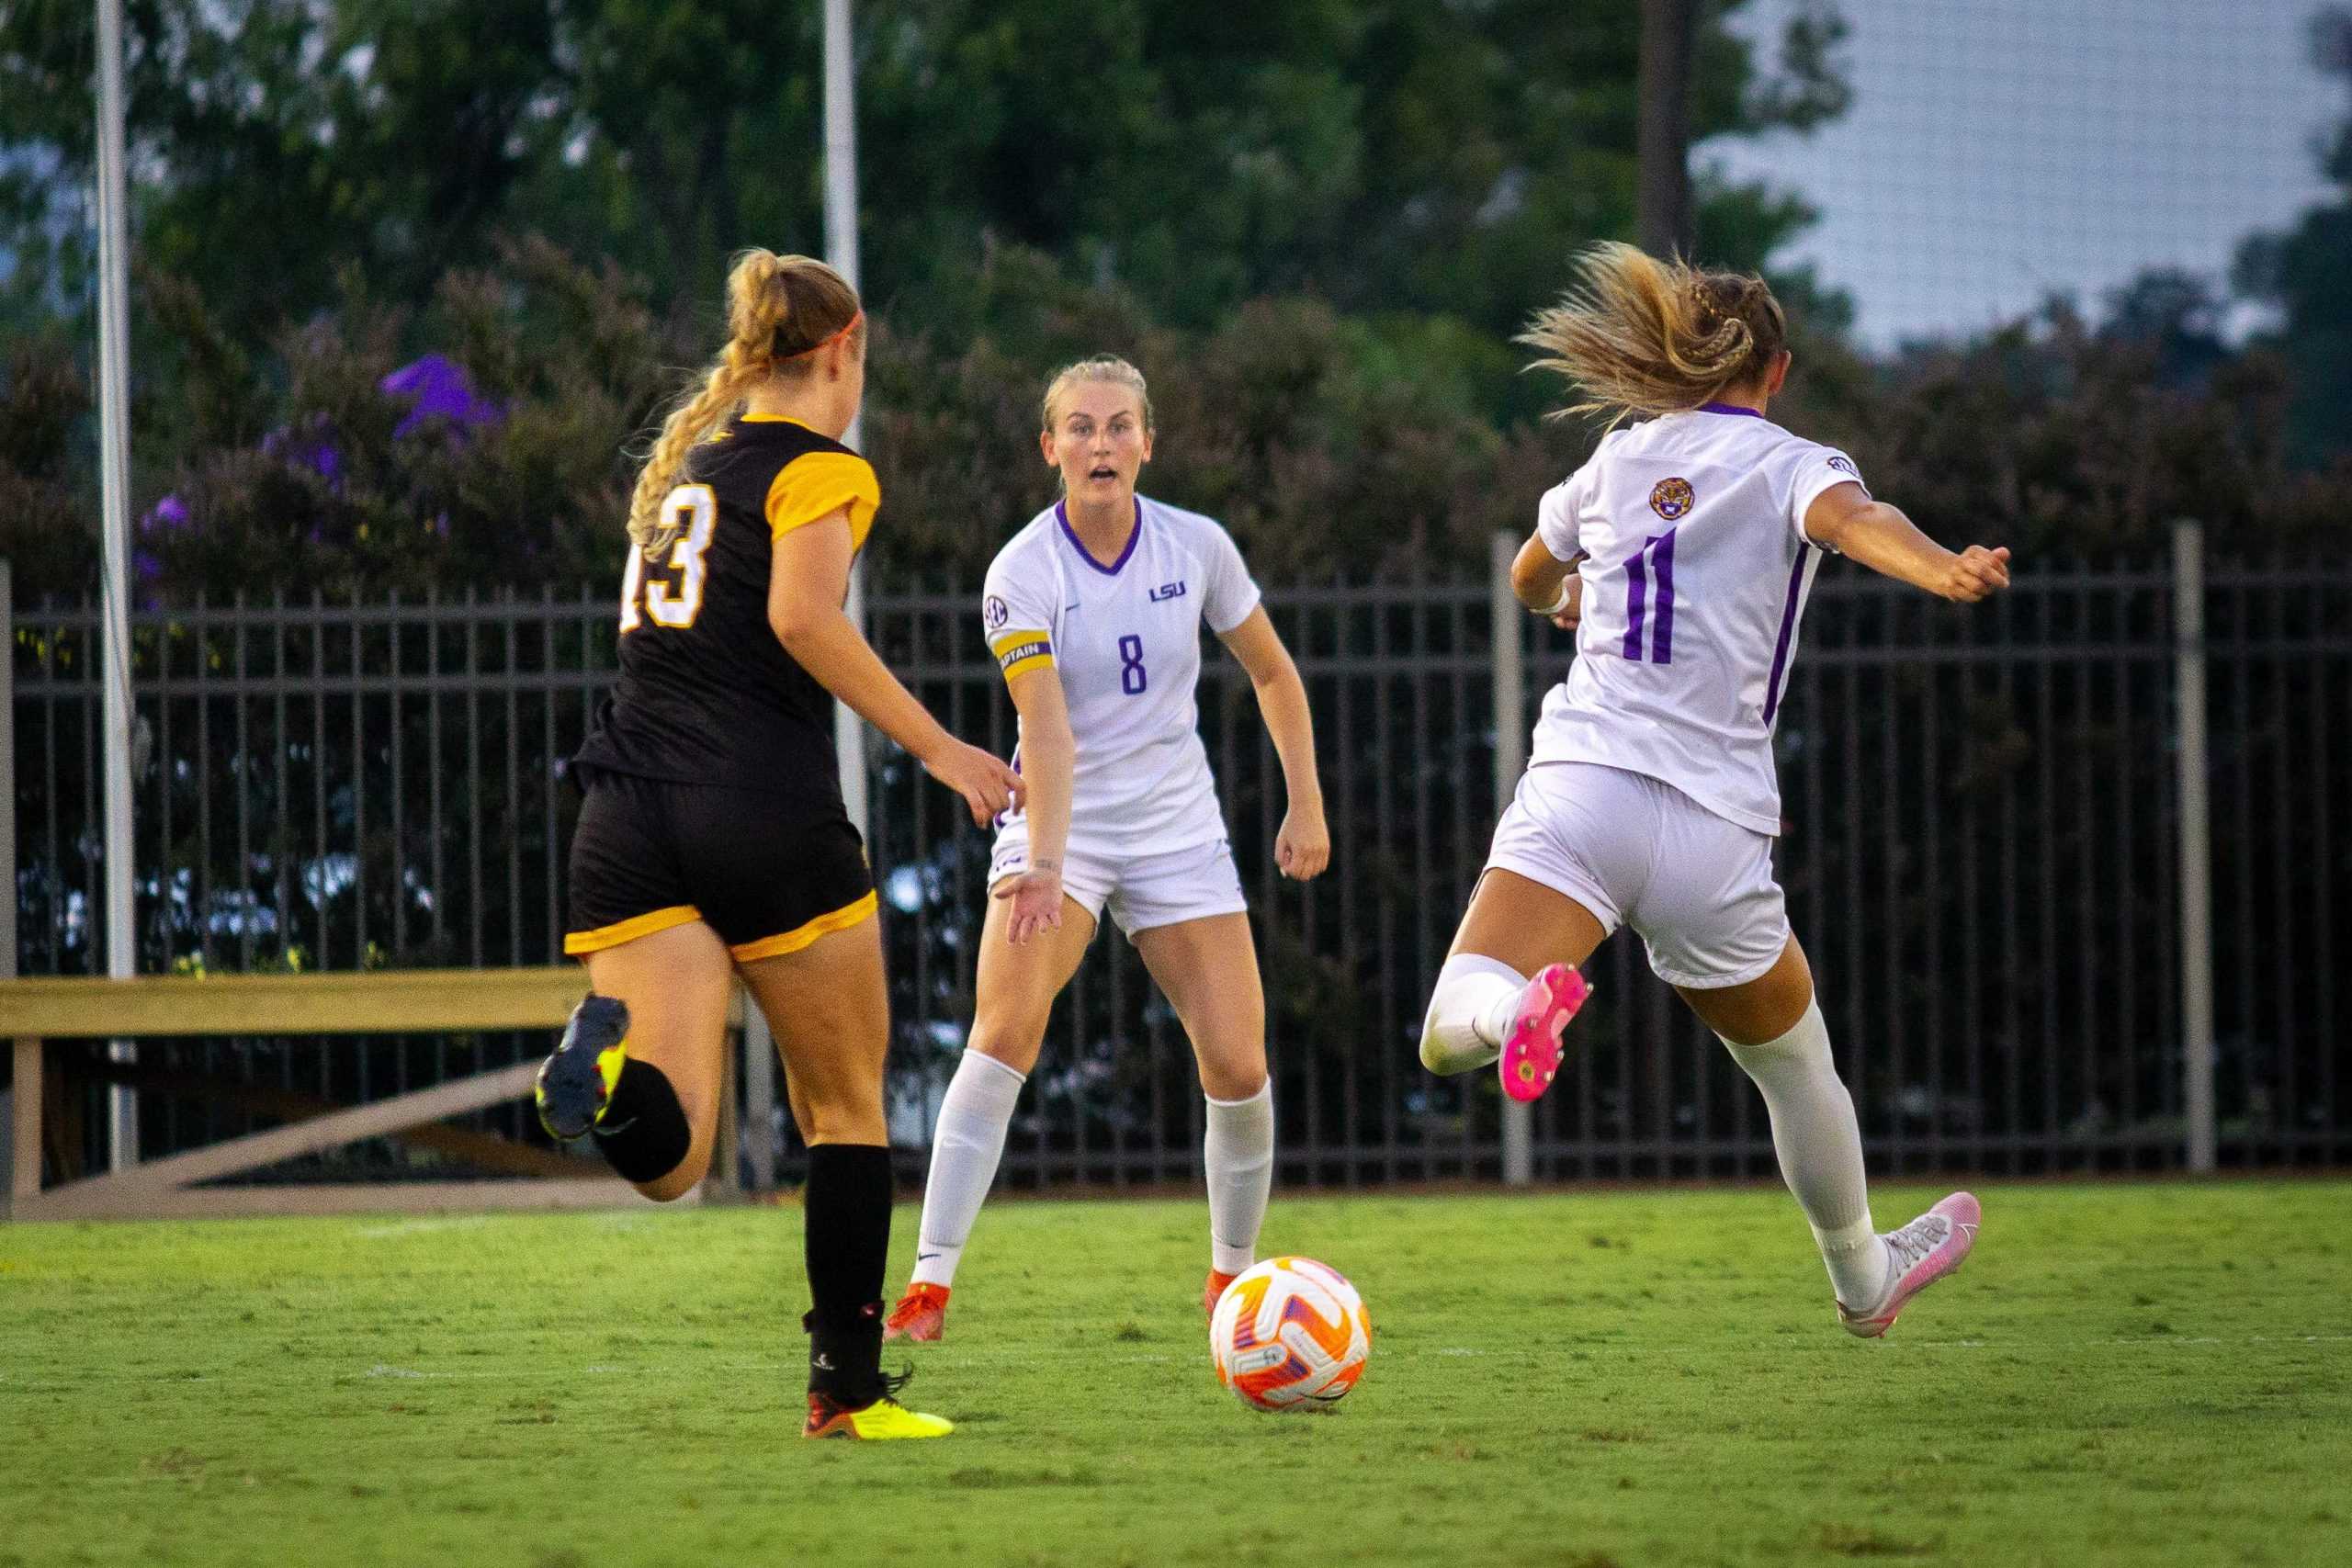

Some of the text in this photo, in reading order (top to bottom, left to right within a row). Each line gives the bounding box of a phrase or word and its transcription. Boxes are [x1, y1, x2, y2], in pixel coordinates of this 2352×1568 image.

[618, 483, 719, 635] 13
[1149, 581, 1186, 602] LSU
[1623, 526, 1676, 664] 11
[1118, 634, 1148, 695] 8
